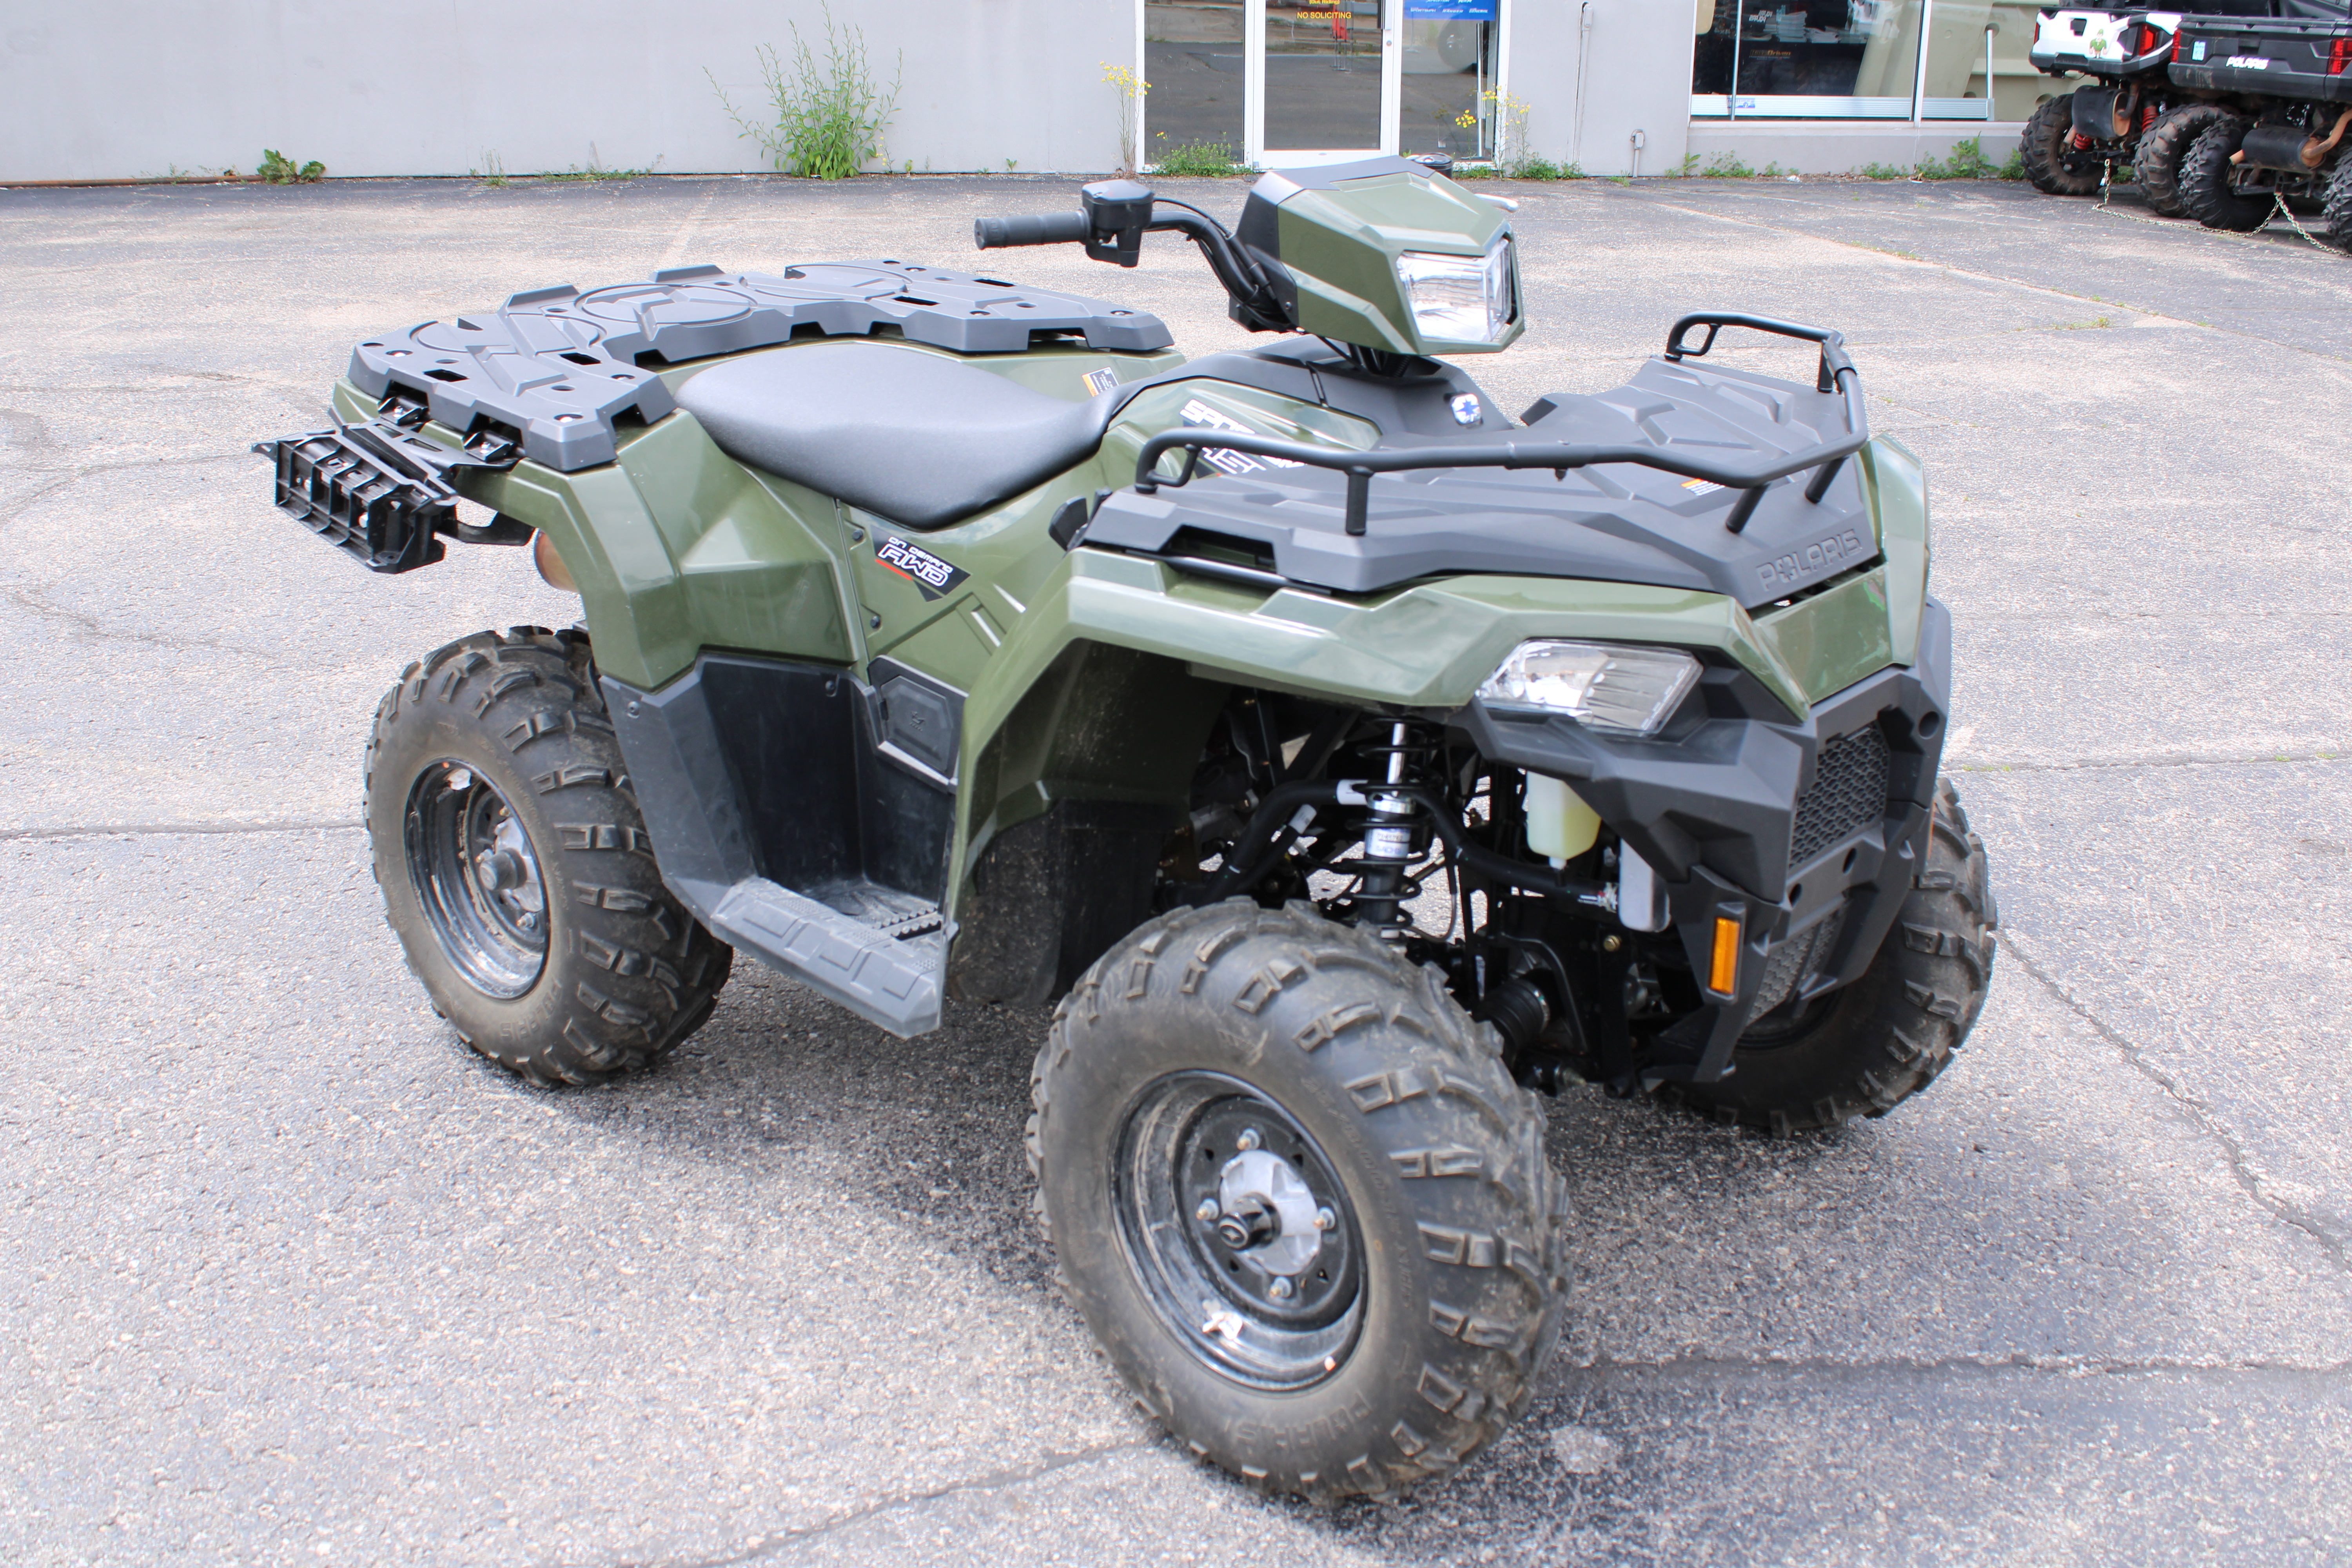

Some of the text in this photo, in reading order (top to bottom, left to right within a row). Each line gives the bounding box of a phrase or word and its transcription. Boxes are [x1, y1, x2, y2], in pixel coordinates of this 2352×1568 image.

[2225, 56, 2270, 70] POLARIS
[877, 543, 949, 587] AWD
[1756, 529, 1862, 592] POLARIS
